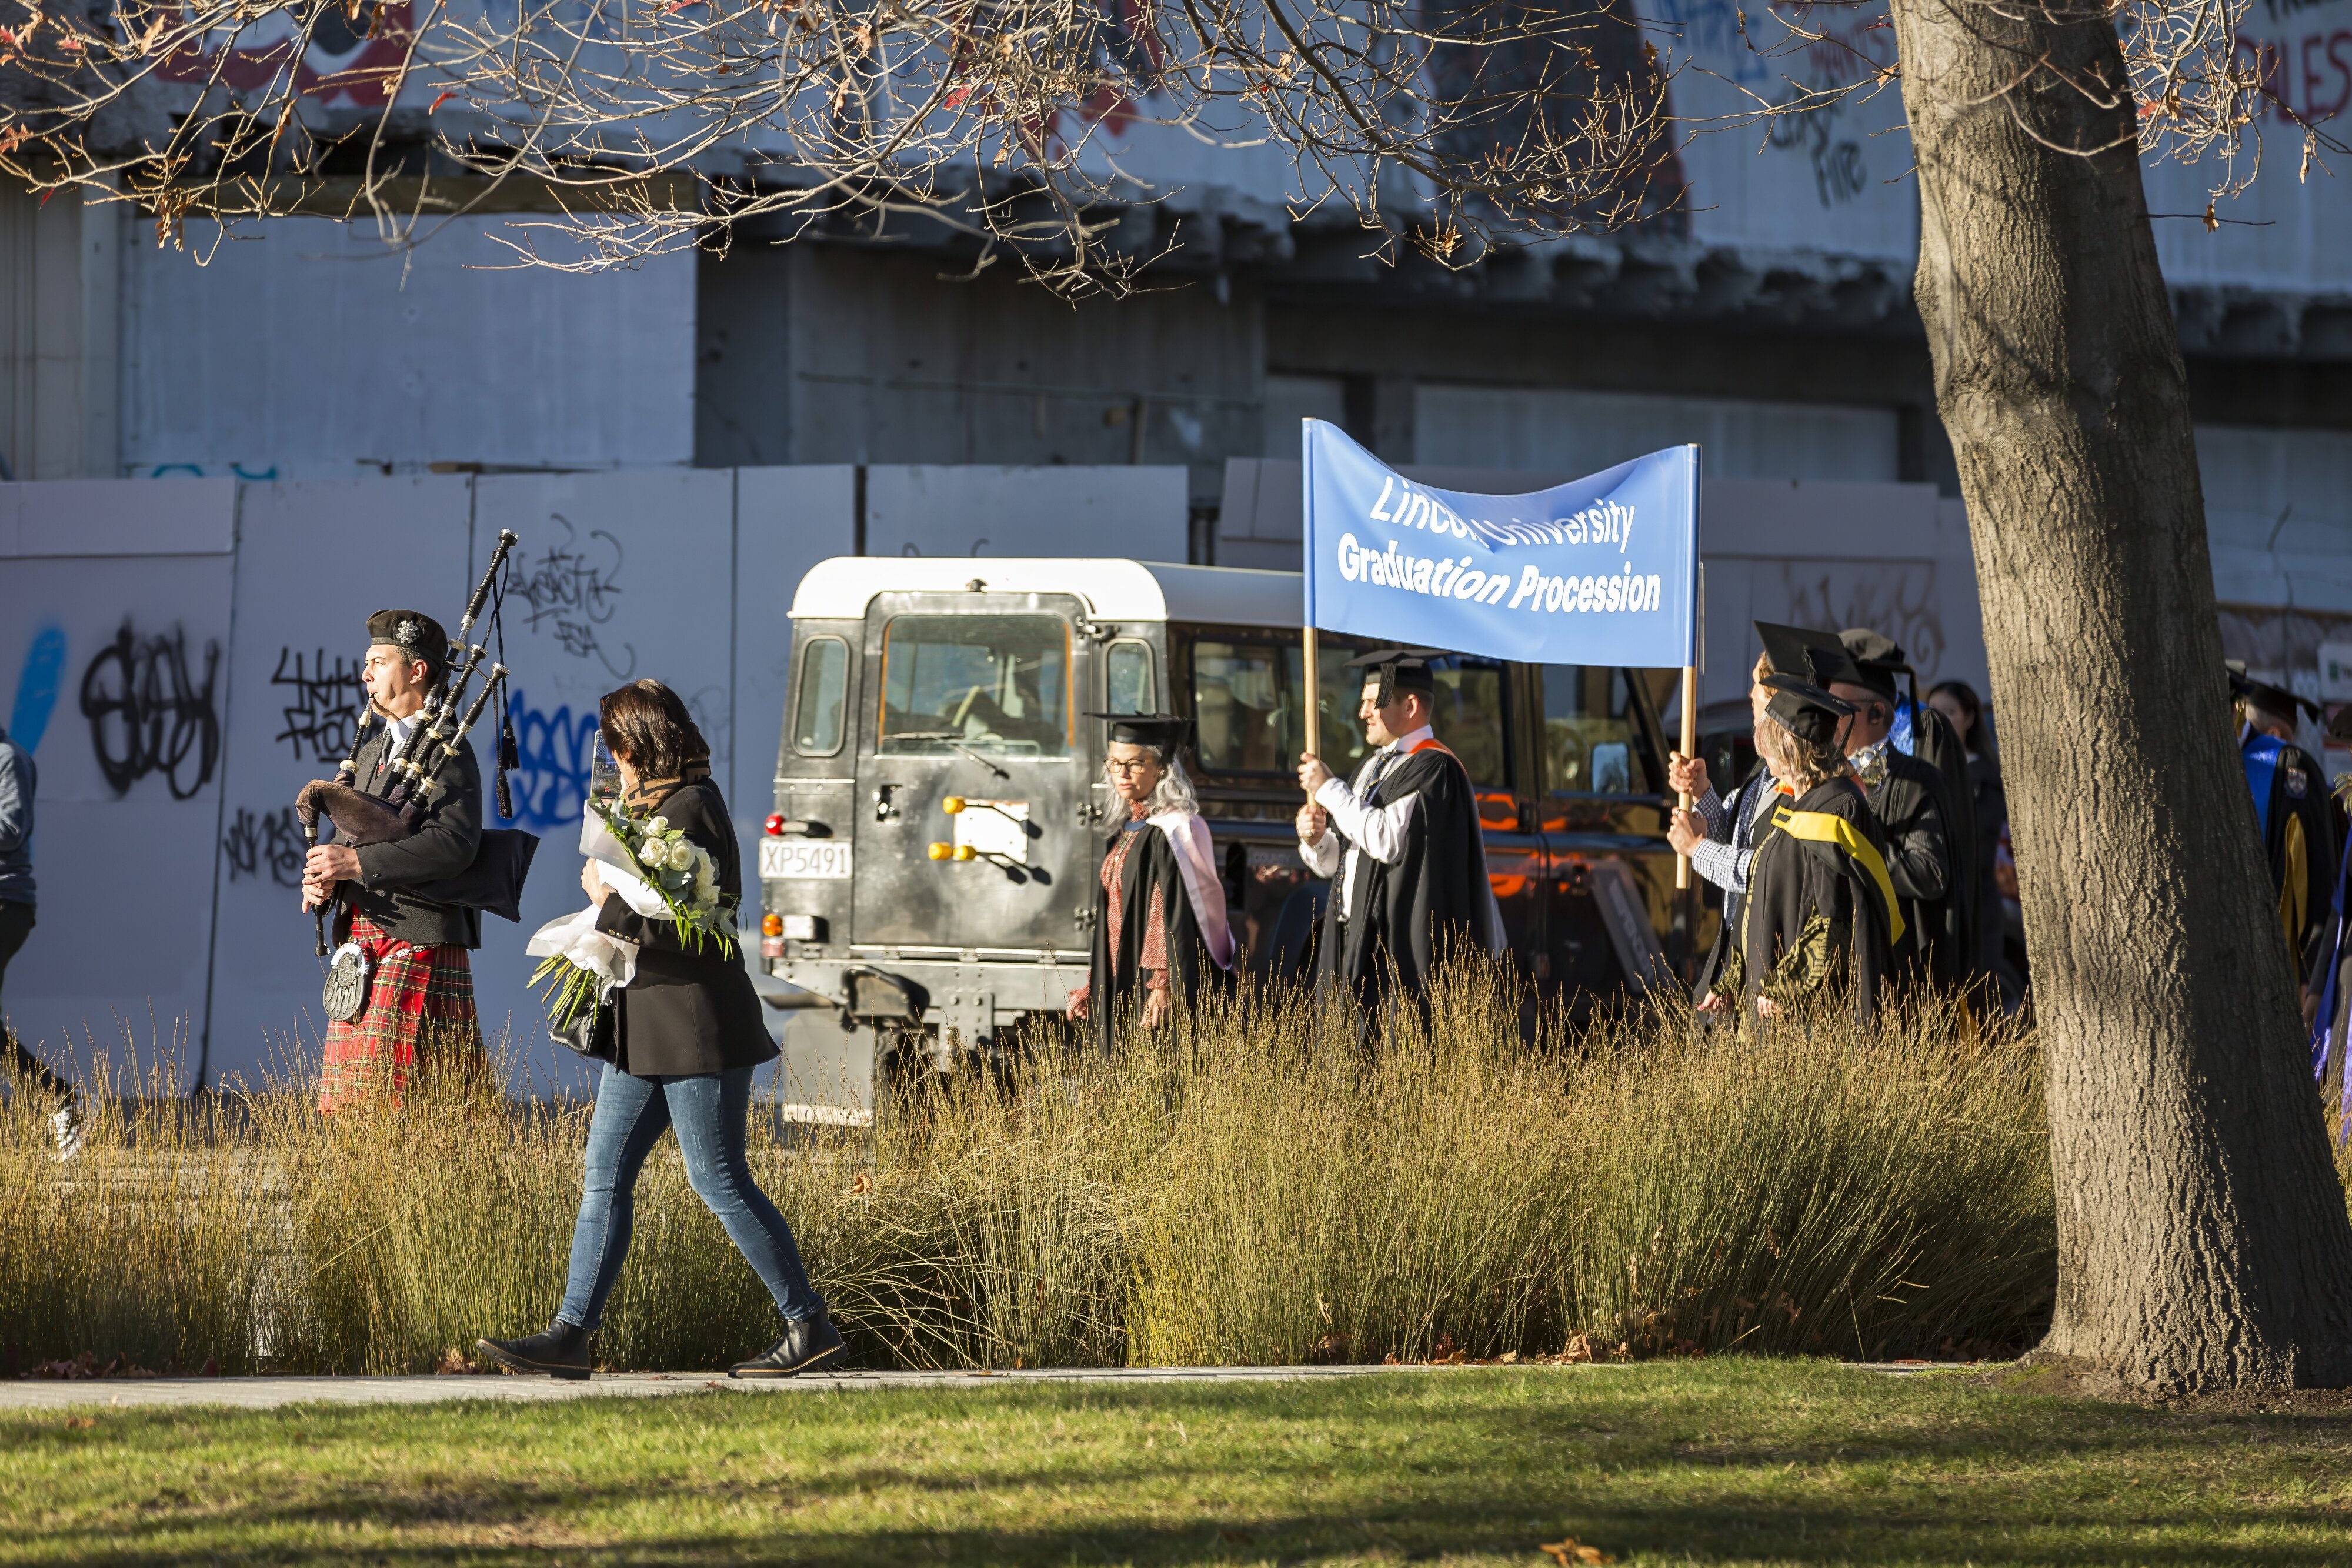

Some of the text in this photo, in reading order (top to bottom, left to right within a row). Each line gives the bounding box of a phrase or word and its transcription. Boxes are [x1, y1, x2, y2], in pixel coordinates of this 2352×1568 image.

[1470, 498, 1636, 554] University
[1337, 532, 1661, 613] Graduation Procession
[766, 846, 847, 874] XP5491
